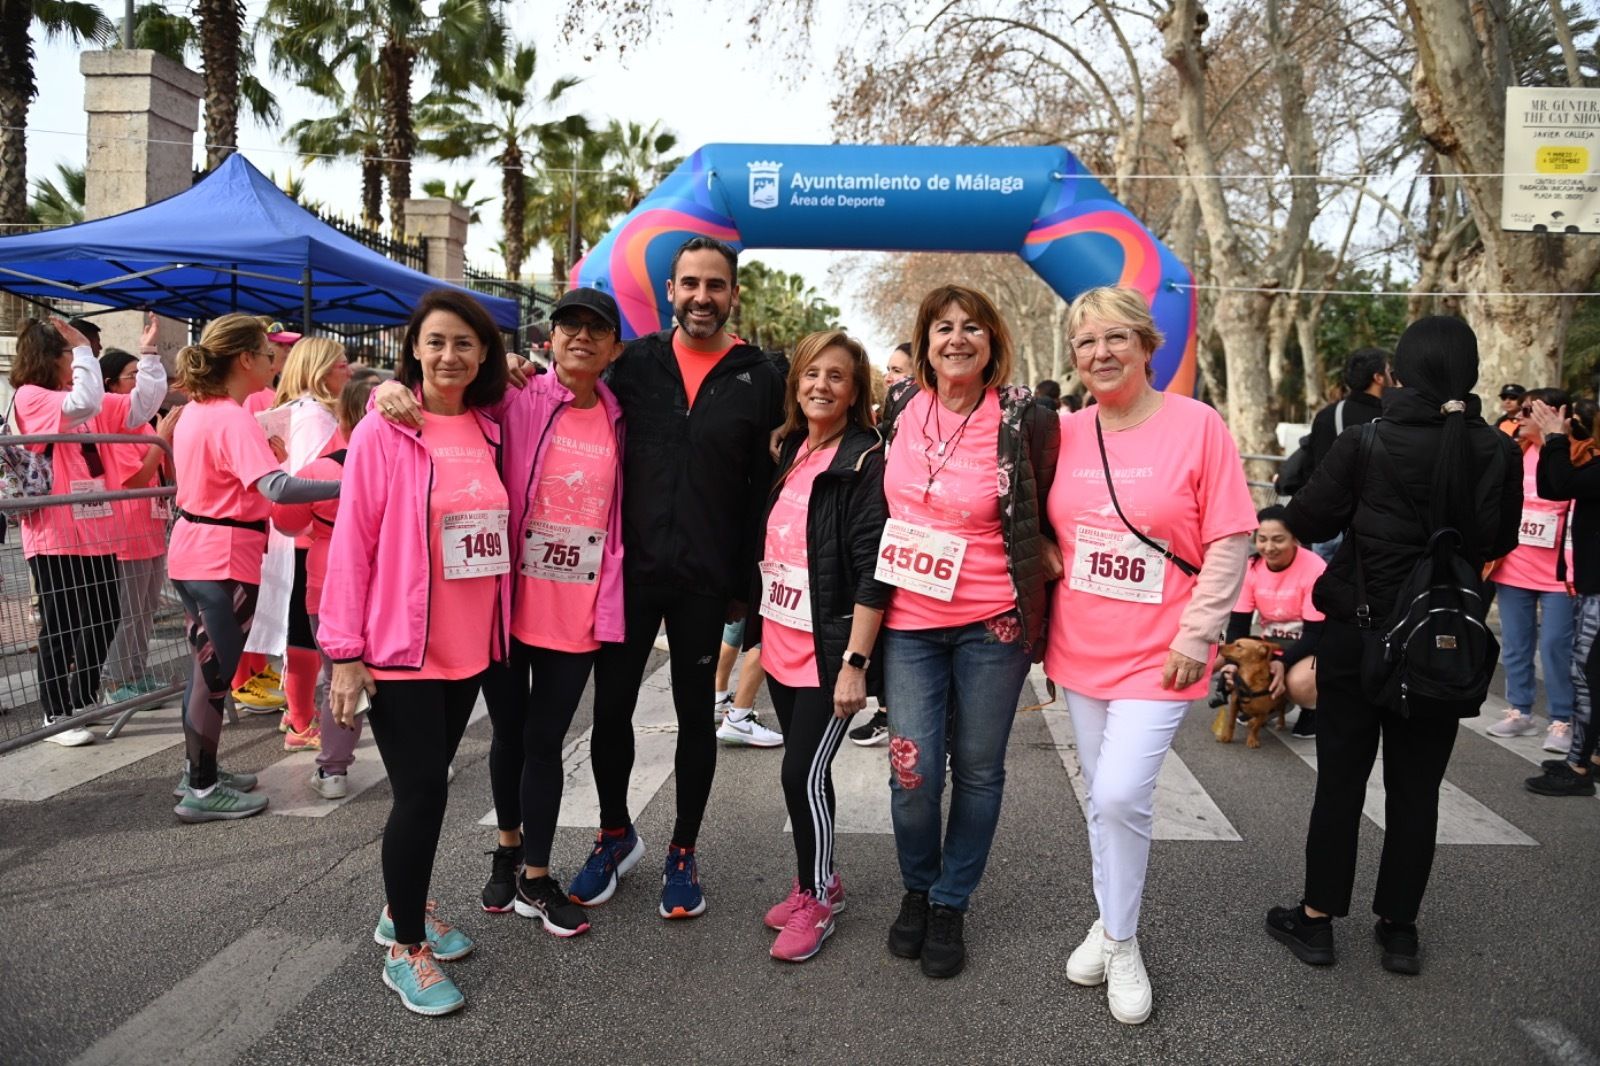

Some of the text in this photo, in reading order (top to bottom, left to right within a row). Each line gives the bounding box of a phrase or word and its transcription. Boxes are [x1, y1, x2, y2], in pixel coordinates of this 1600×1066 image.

[1524, 112, 1600, 124] THE CAT SHO
[1564, 130, 1595, 139] CALLEJA
[790, 172, 1024, 194] Ayuntamiento de Málaga
[790, 194, 885, 208] Área de Deporte
[1518, 522, 1545, 536] 437
[461, 532, 502, 558] 1499
[543, 541, 580, 567] 755
[881, 544, 954, 580] 4506
[1089, 551, 1146, 583] 1536
[770, 581, 802, 610] 3077
